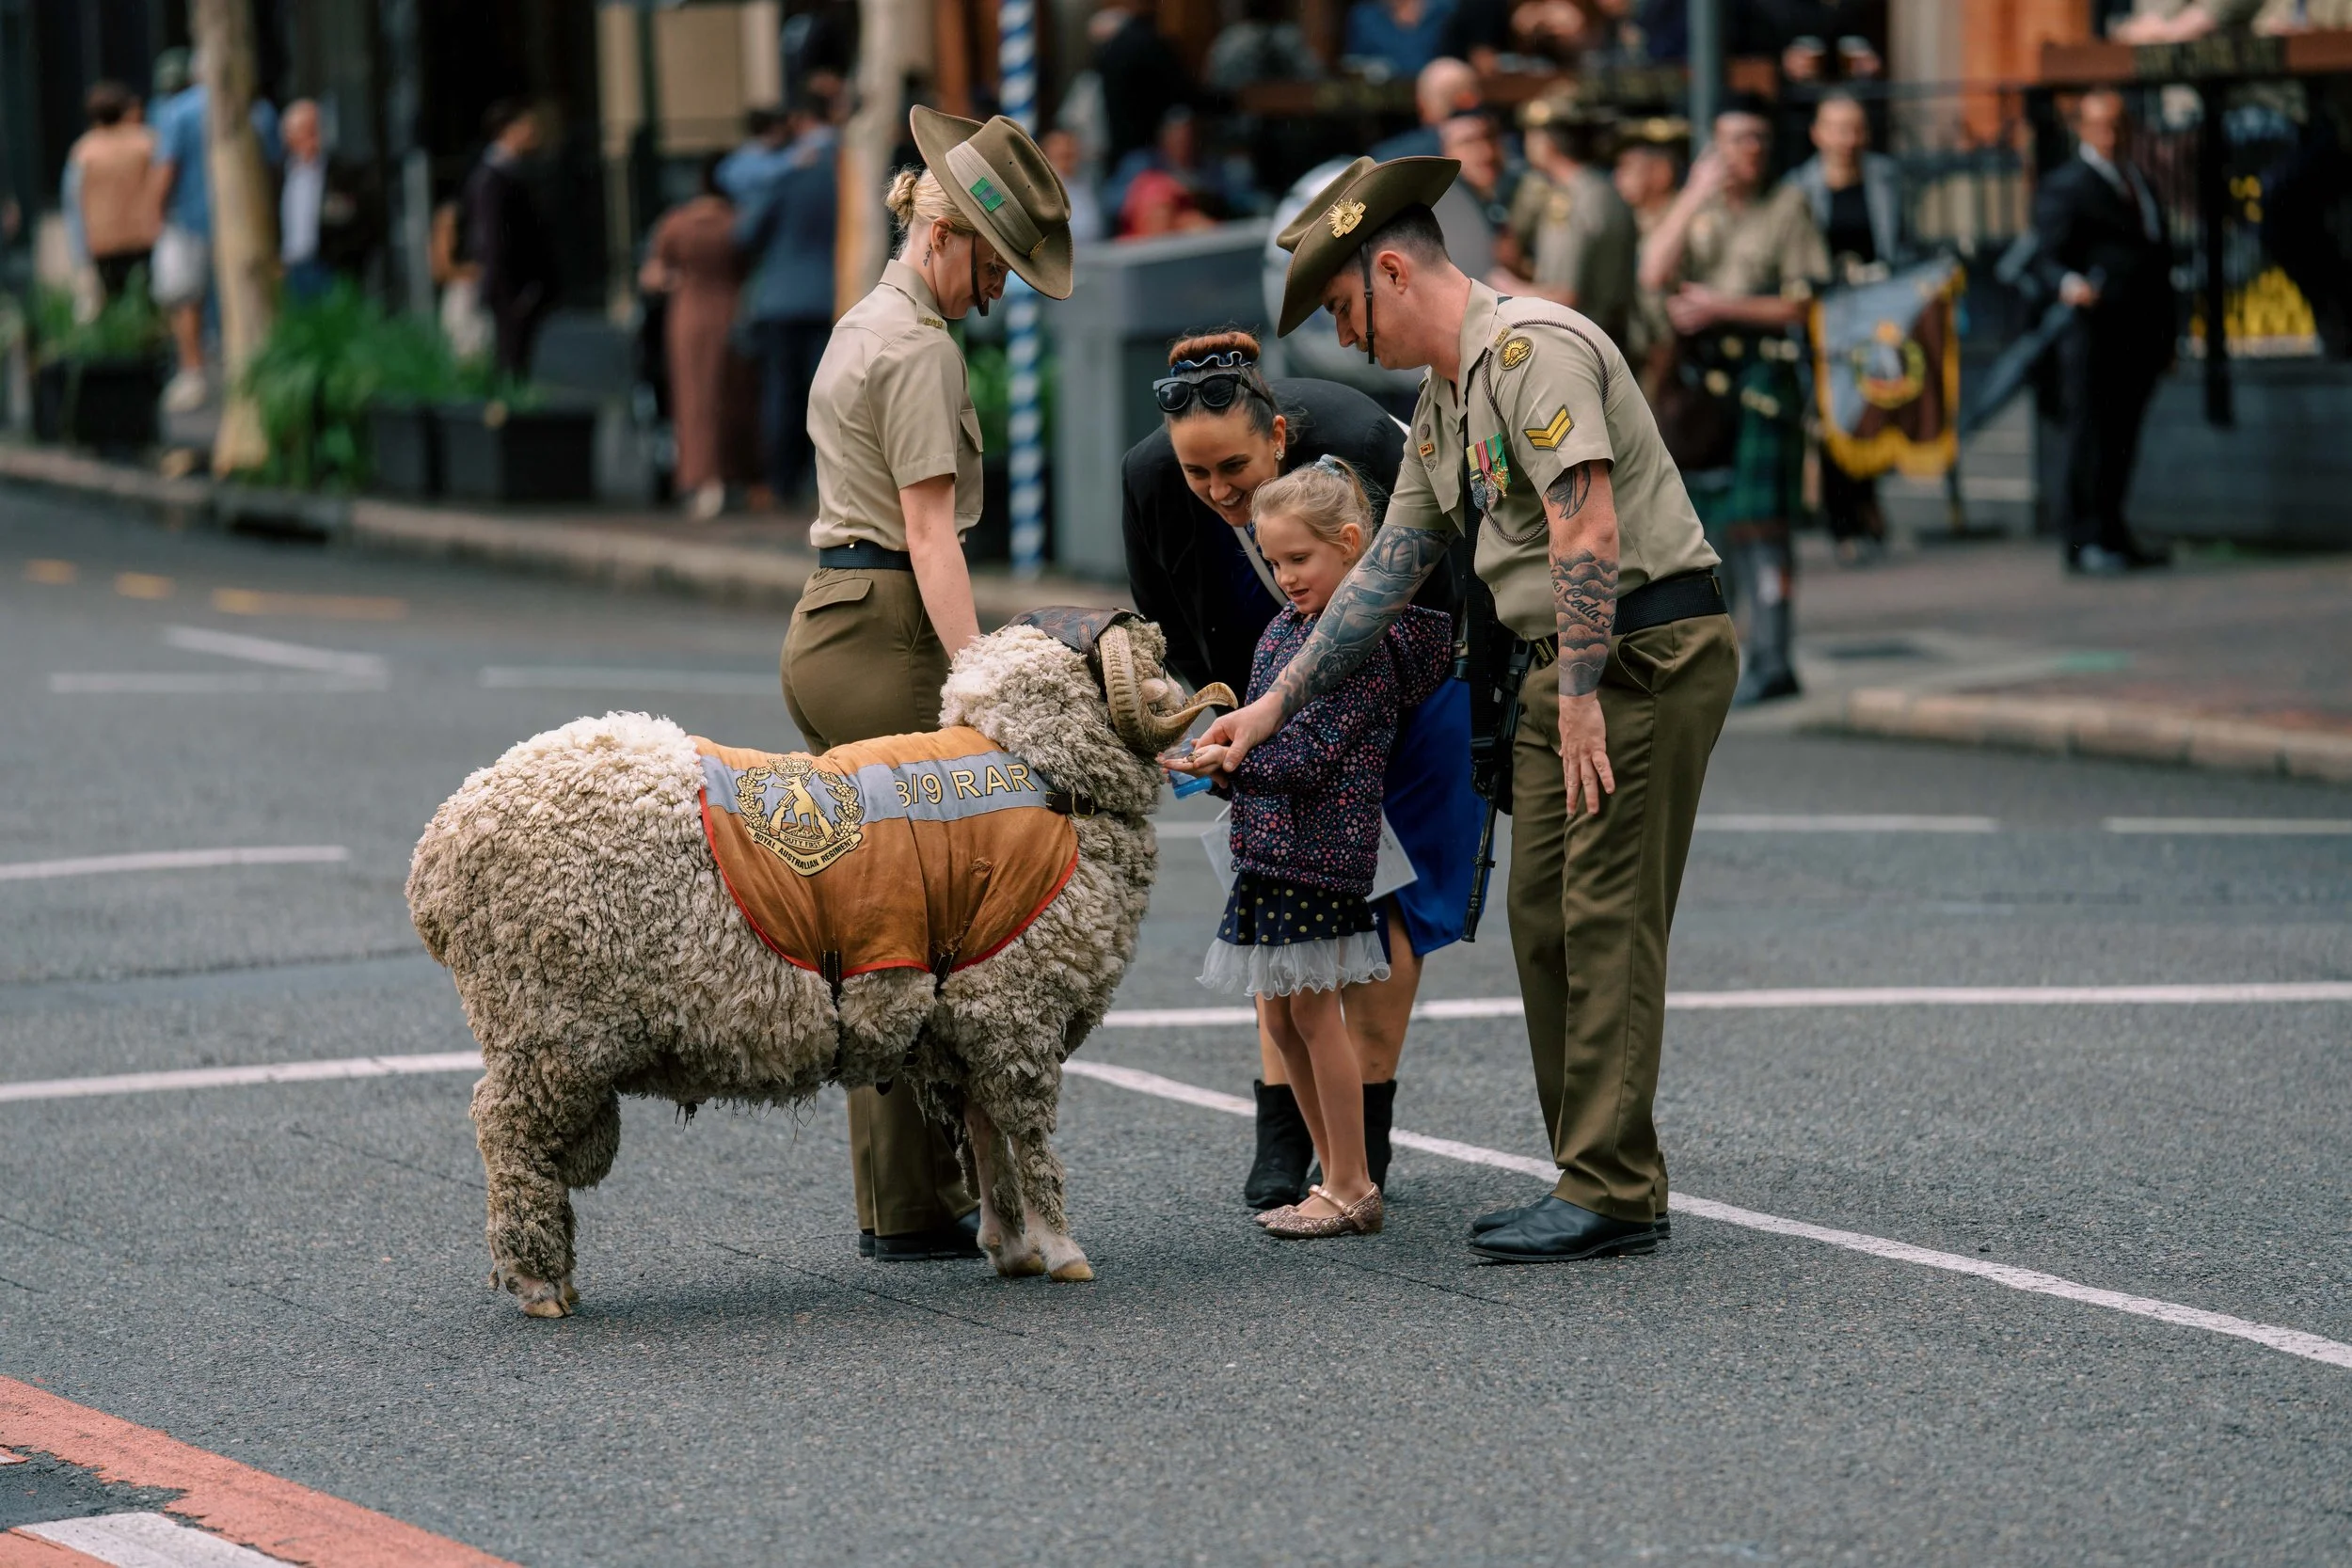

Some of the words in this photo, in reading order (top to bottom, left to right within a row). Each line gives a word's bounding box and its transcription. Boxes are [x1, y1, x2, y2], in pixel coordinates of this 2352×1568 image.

[949, 762, 1038, 800] RAR
[754, 832, 776, 850] ROYAL
[778, 847, 819, 870] AUSTRALIAN
[820, 837, 854, 863] REGIMENT
[784, 835, 803, 847] DUTY
[804, 839, 822, 848] FIRST
